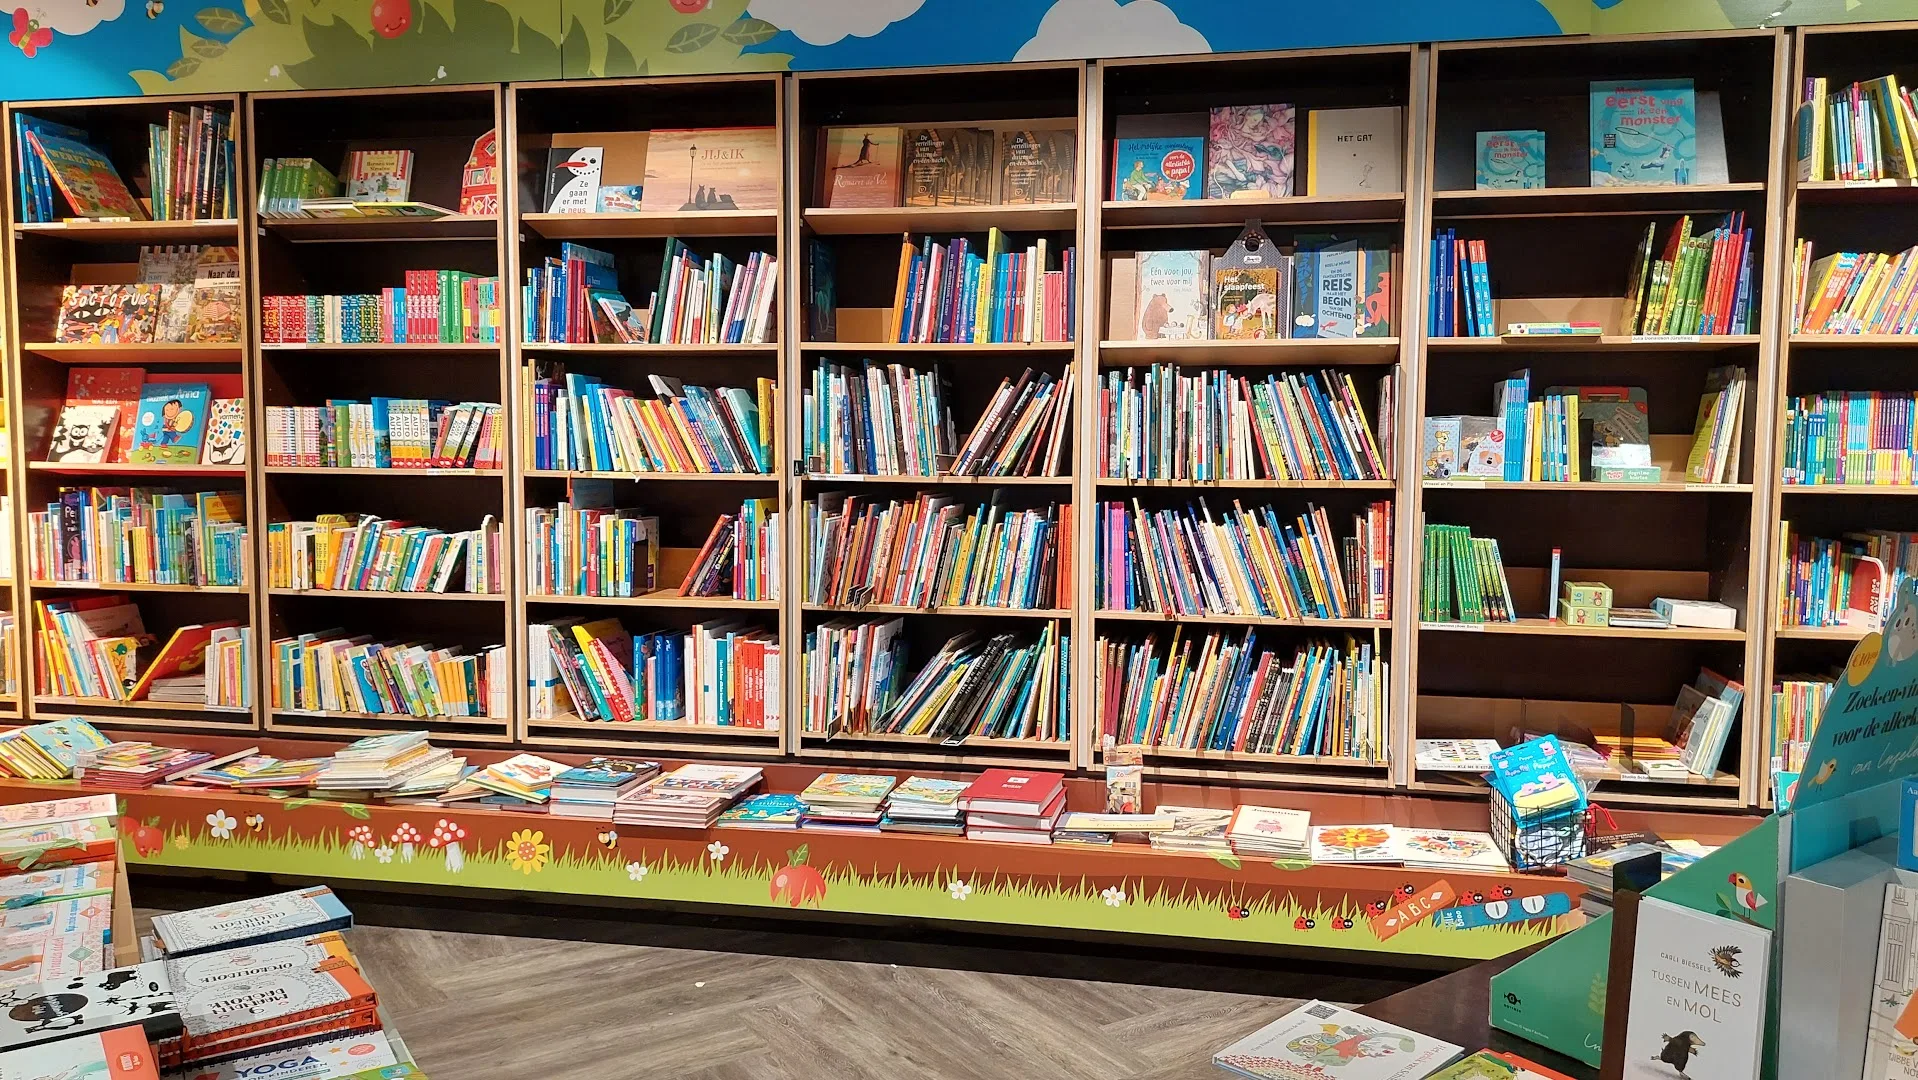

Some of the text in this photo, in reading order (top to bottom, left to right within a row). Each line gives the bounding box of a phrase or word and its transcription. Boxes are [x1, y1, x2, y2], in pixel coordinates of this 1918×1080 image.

[1605, 96, 1656, 109] eerst
[1637, 107, 1646, 115] ik
[1620, 116, 1681, 126] monster
[1356, 134, 1373, 142] GAT
[1486, 140, 1514, 148] eerst
[1170, 166, 1190, 177] papa!
[569, 190, 588, 198] gaan
[558, 206, 586, 214] je neus
[208, 270, 226, 279] Naar
[1164, 268, 1179, 276] voor
[1182, 277, 1193, 286] mij
[1322, 278, 1353, 292] REIS
[1224, 283, 1265, 292] slaapfeest
[69, 292, 151, 308] SOCTOPUS
[1322, 296, 1352, 308] BEGIN
[1322, 310, 1352, 320] OCHTEND
[178, 388, 199, 399] Anna
[1574, 592, 1582, 602] 16
[1597, 613, 1606, 622] 16
[1833, 727, 1863, 748] voor
[1863, 717, 1880, 739] de
[1682, 958, 1712, 973] BIESSELS
[1652, 969, 1742, 1008] TUSSEN MEES
[249, 1007, 264, 1015] 9
[1666, 996, 1722, 1024] EN MOL
[234, 1056, 321, 1078] YOGA
[268, 1062, 328, 1078] KINDEREN
